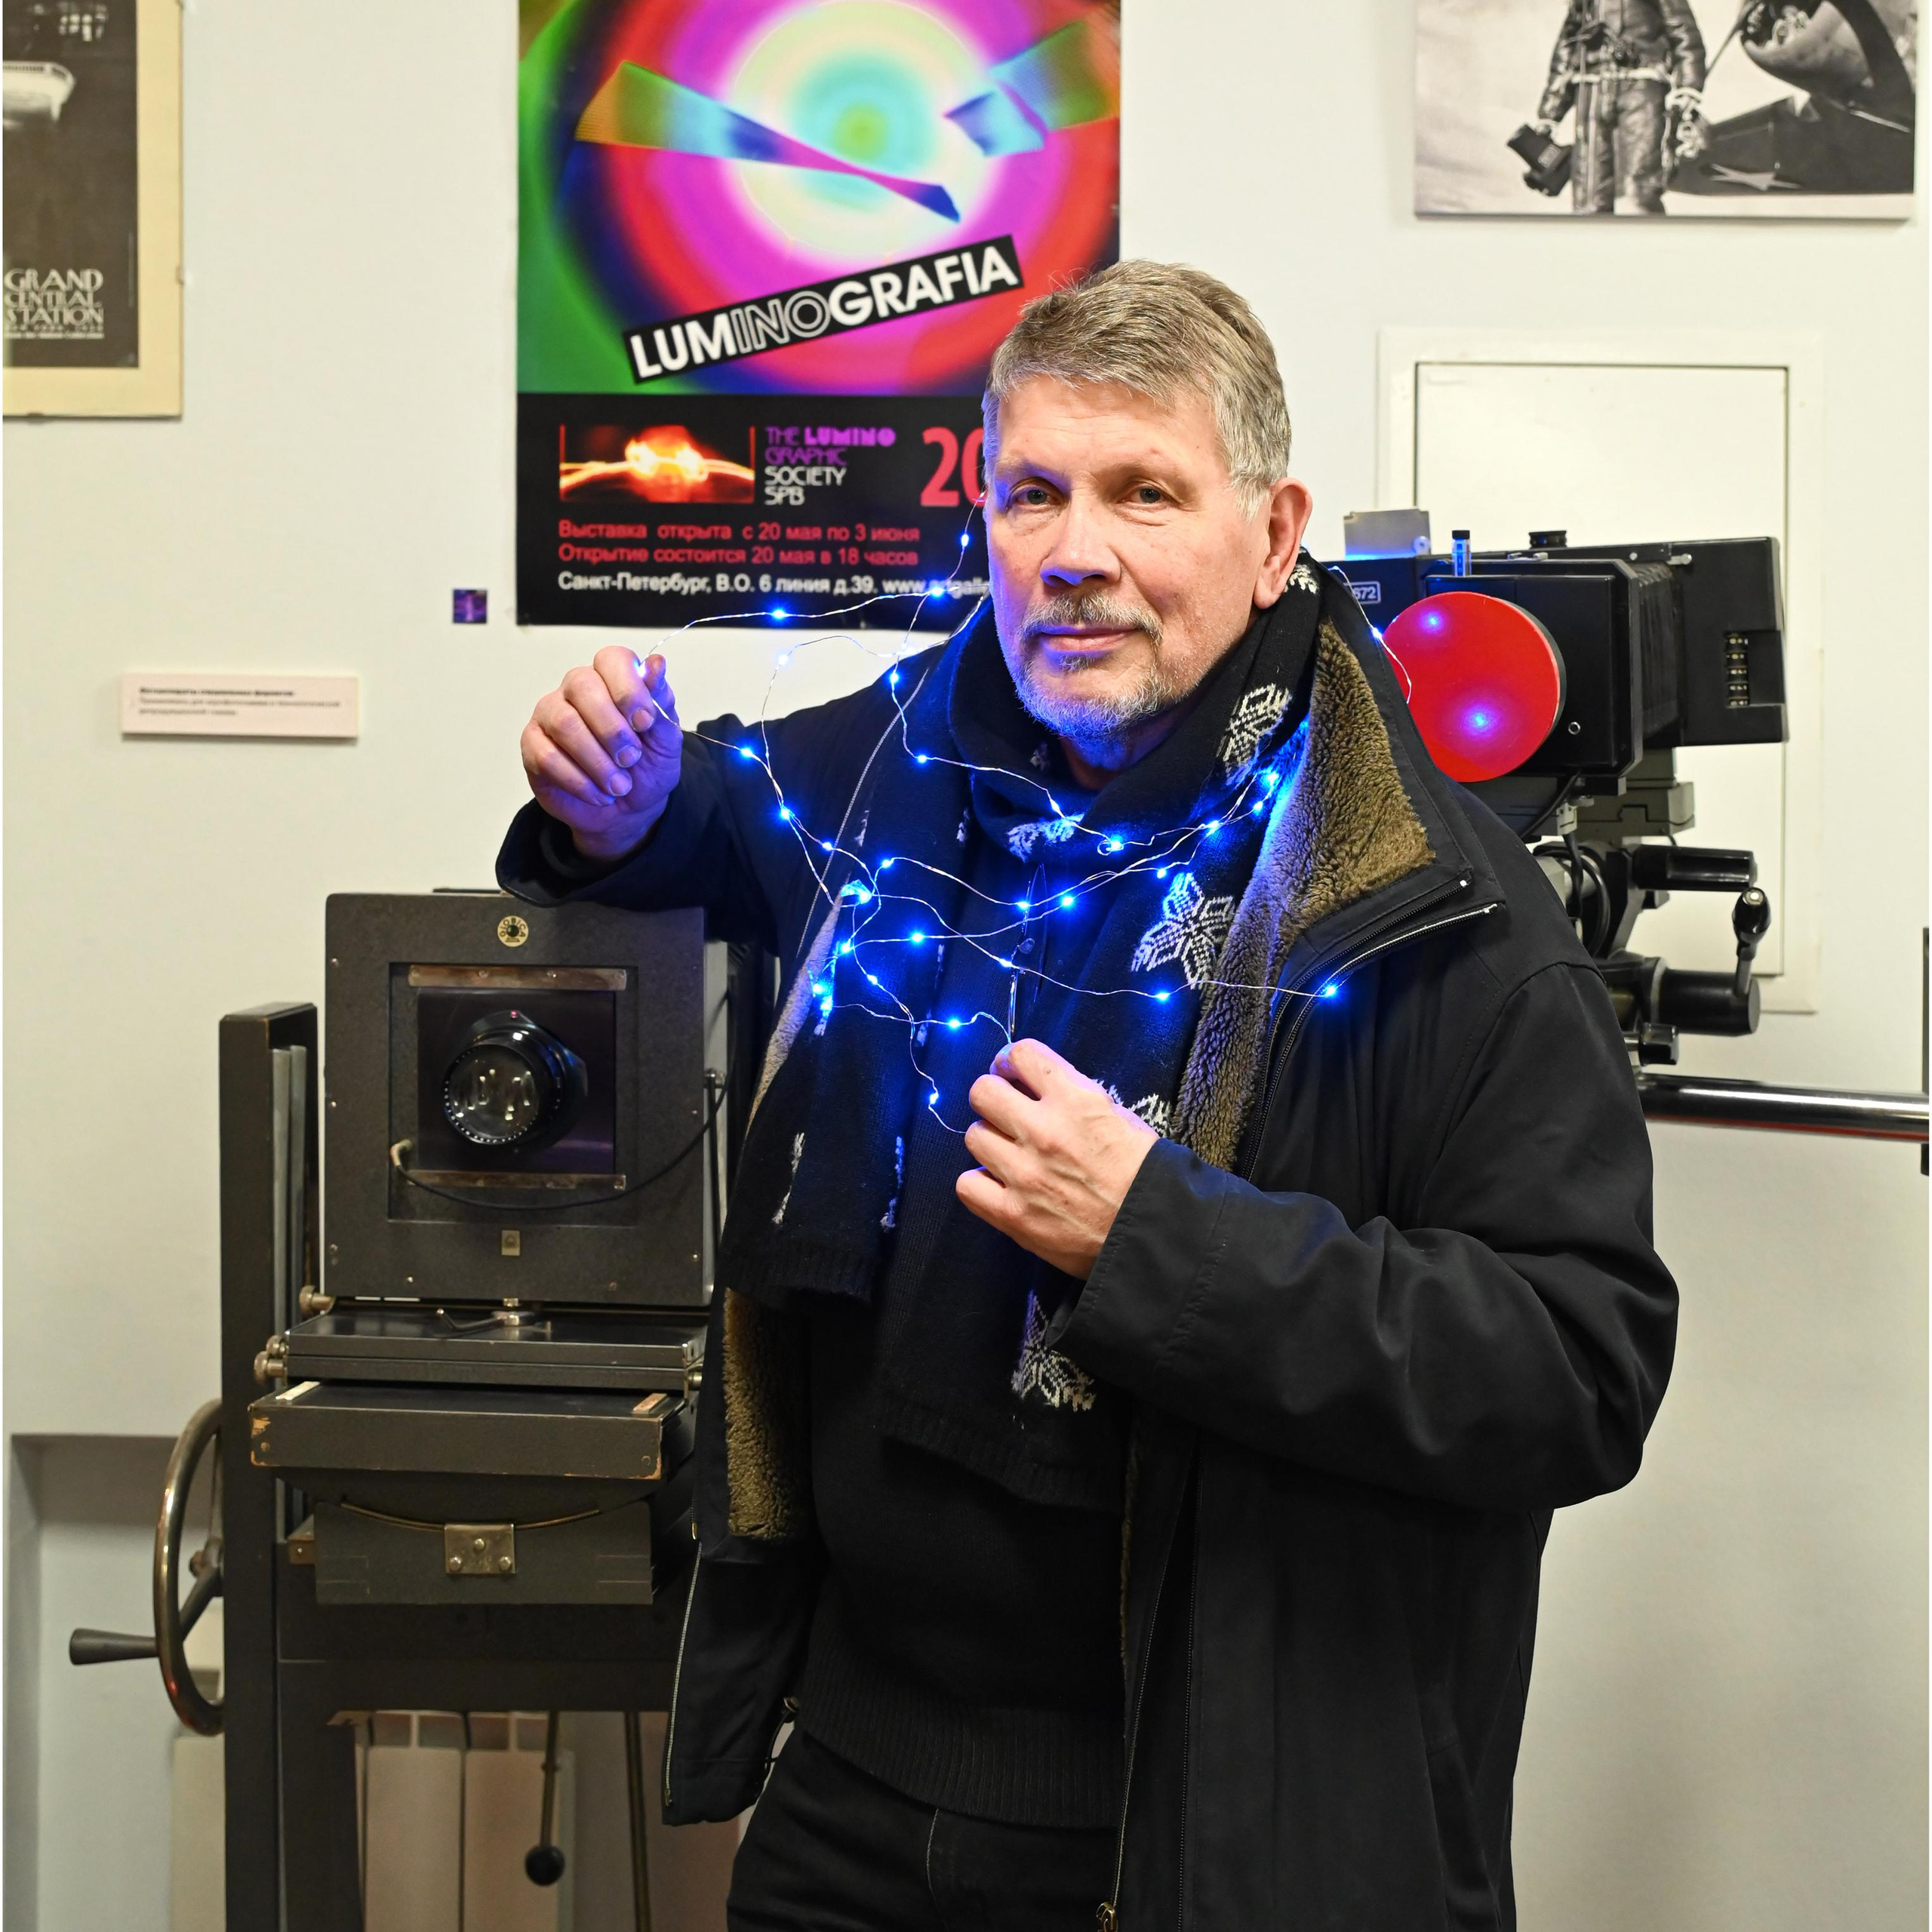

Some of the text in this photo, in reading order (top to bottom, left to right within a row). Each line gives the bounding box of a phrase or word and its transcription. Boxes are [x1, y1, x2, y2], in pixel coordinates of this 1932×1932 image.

[4, 268, 104, 293] GRAND
[6, 307, 104, 325] STATION
[630, 246, 1019, 378] LUMINOGRAFIA
[764, 426, 896, 447] THE LUMINO
[764, 466, 847, 486] SOCIETY
[764, 485, 804, 506] SPB
[558, 519, 648, 538] Выставка
[657, 525, 732, 543] открыта
[758, 522, 781, 540] 20
[786, 526, 822, 540] мая
[826, 527, 850, 541] по
[855, 523, 866, 541] 3
[871, 528, 920, 541] июня
[558, 543, 649, 565] Открытие
[654, 548, 746, 563] состоится
[751, 546, 774, 564] 20
[780, 550, 815, 564] мая
[838, 547, 859, 565] 18
[864, 552, 918, 565] часов
[558, 571, 712, 595] Санкт-Петербург,
[715, 574, 755, 592] В.О.
[759, 574, 772, 592] 6
[775, 579, 829, 593] линия
